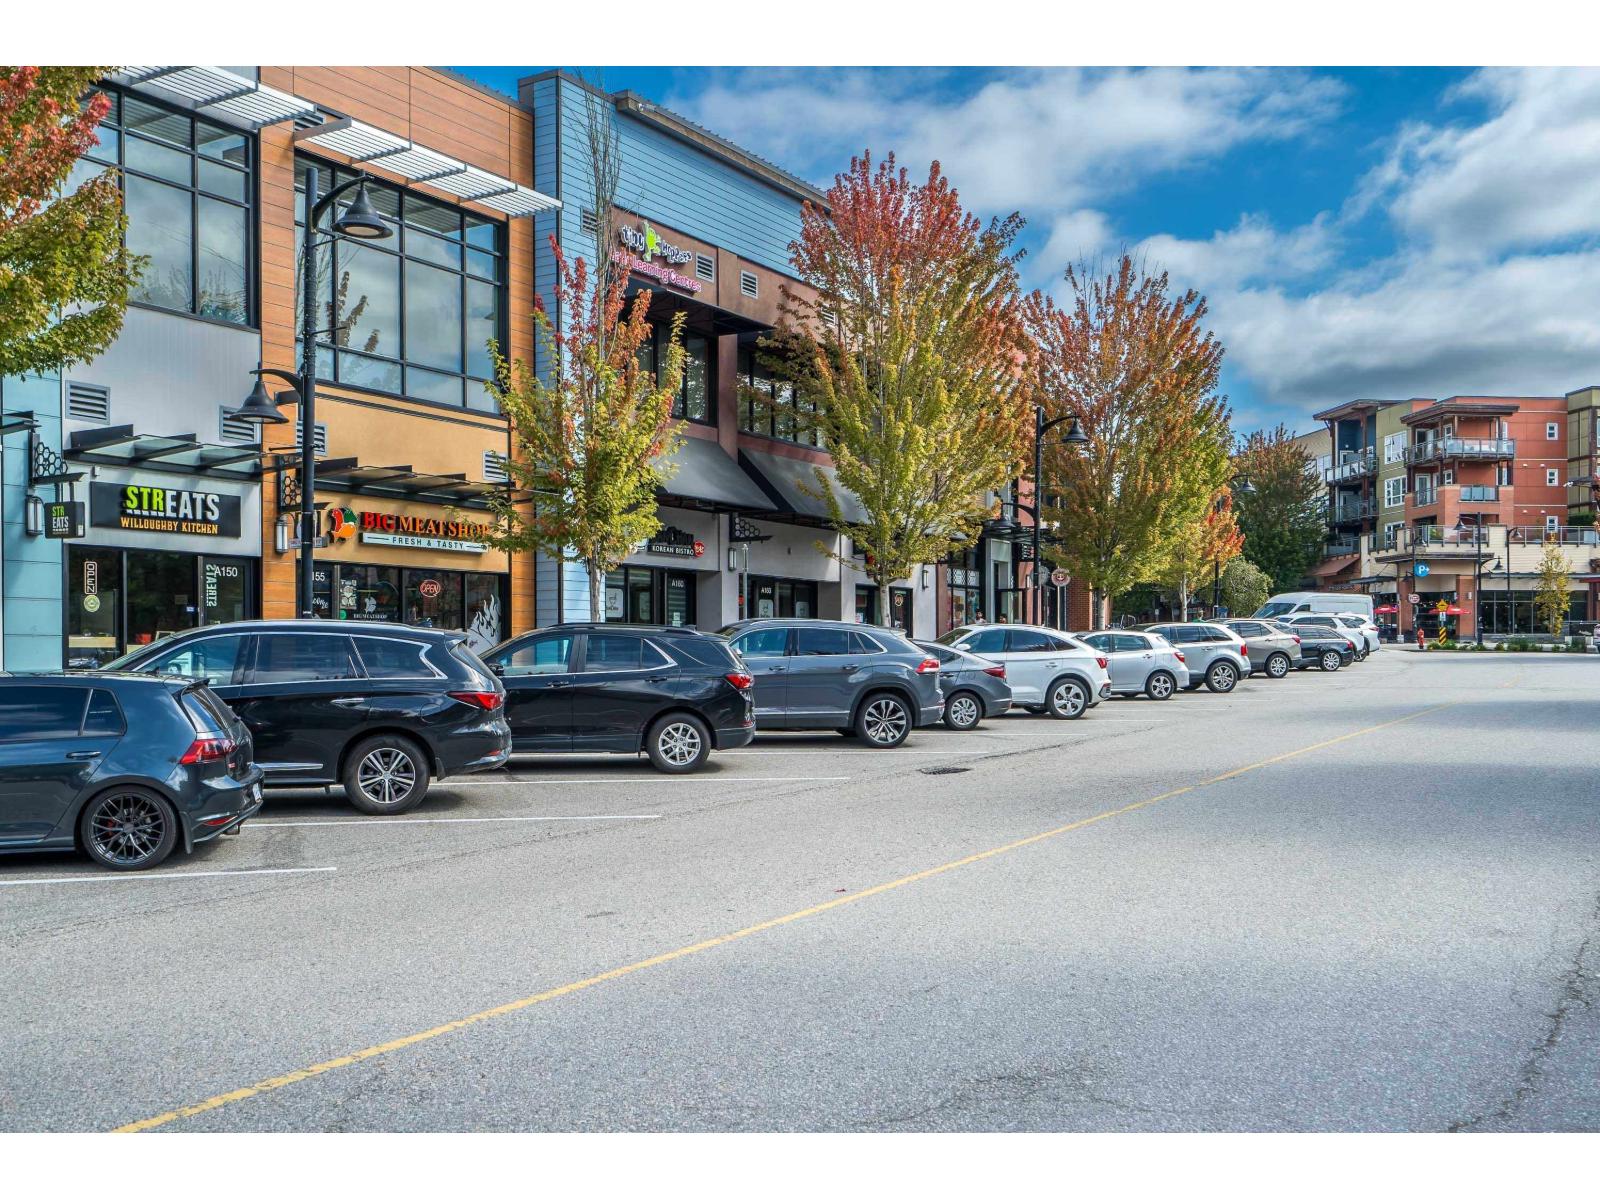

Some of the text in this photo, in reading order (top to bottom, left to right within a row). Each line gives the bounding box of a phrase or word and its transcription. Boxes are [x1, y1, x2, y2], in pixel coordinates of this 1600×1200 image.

[633, 255, 669, 284] Learning
[669, 268, 702, 292] Centres
[126, 485, 220, 521] STREATS
[52, 505, 65, 517] STR
[52, 516, 69, 529] EATS
[120, 516, 219, 534] WILLOUGHBY KITCHEN
[362, 511, 396, 532] BIG
[392, 536, 465, 549] FRESH & TASTY
[652, 545, 674, 554] KOREAN
[675, 547, 695, 557] BISTRO
[215, 565, 238, 577] A150
[86, 563, 95, 593] OPEN
[421, 583, 440, 593] OPEN
